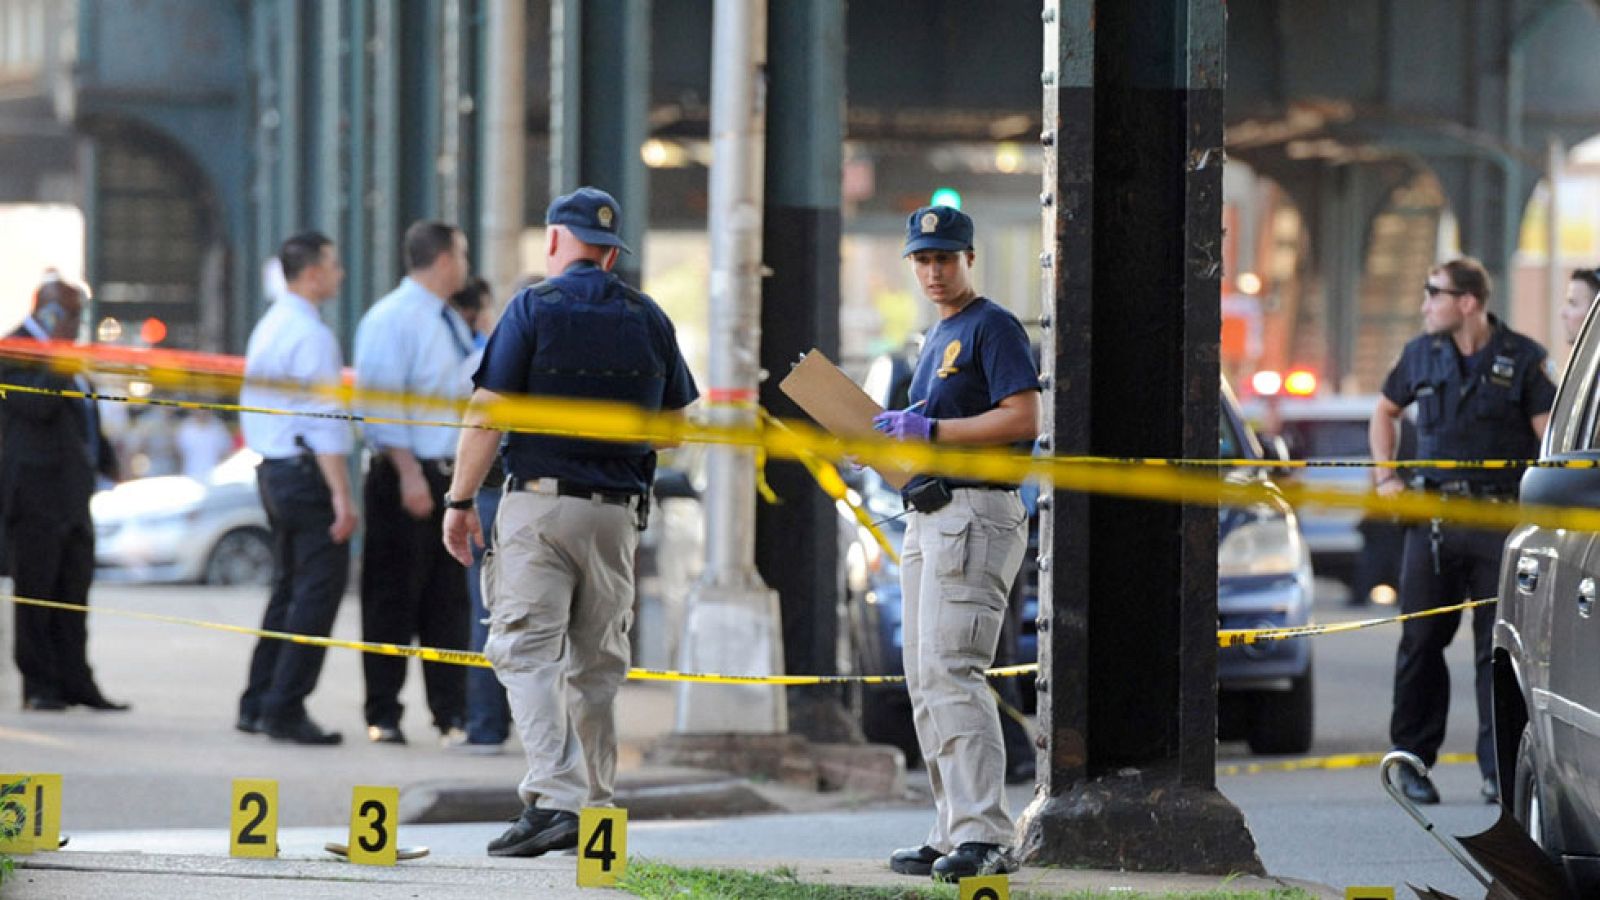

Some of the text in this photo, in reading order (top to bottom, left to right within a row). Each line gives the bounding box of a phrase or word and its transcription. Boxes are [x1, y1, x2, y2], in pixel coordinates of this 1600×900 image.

[237, 791, 268, 844] 2
[358, 800, 388, 852] 3
[584, 818, 616, 872] 4
